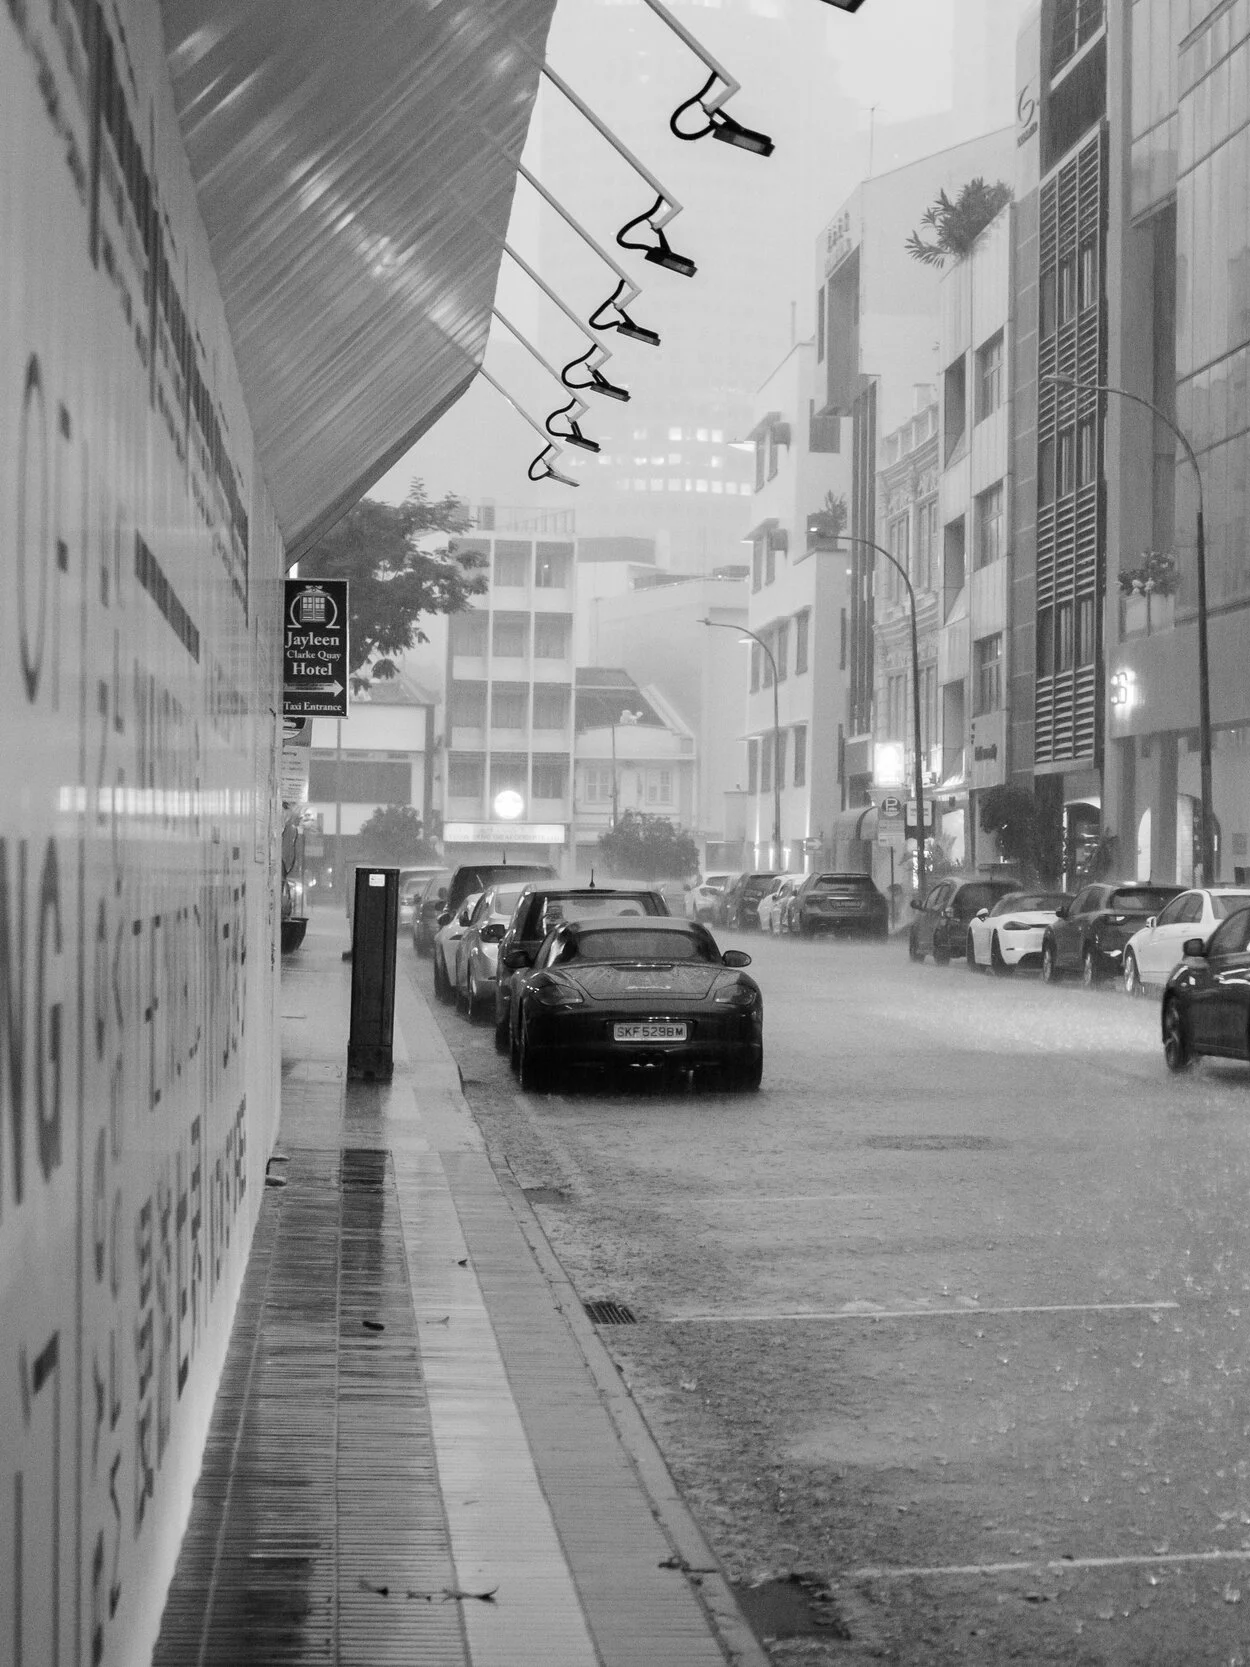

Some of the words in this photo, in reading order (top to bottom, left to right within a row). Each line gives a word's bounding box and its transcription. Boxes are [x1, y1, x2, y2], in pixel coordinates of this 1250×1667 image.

[285, 631, 340, 650] Jayleen
[286, 650, 316, 659] Clarke
[317, 650, 342, 661] Quay
[292, 662, 333, 675] Hotel
[284, 701, 302, 711] Taxi
[303, 701, 343, 711] Entrance
